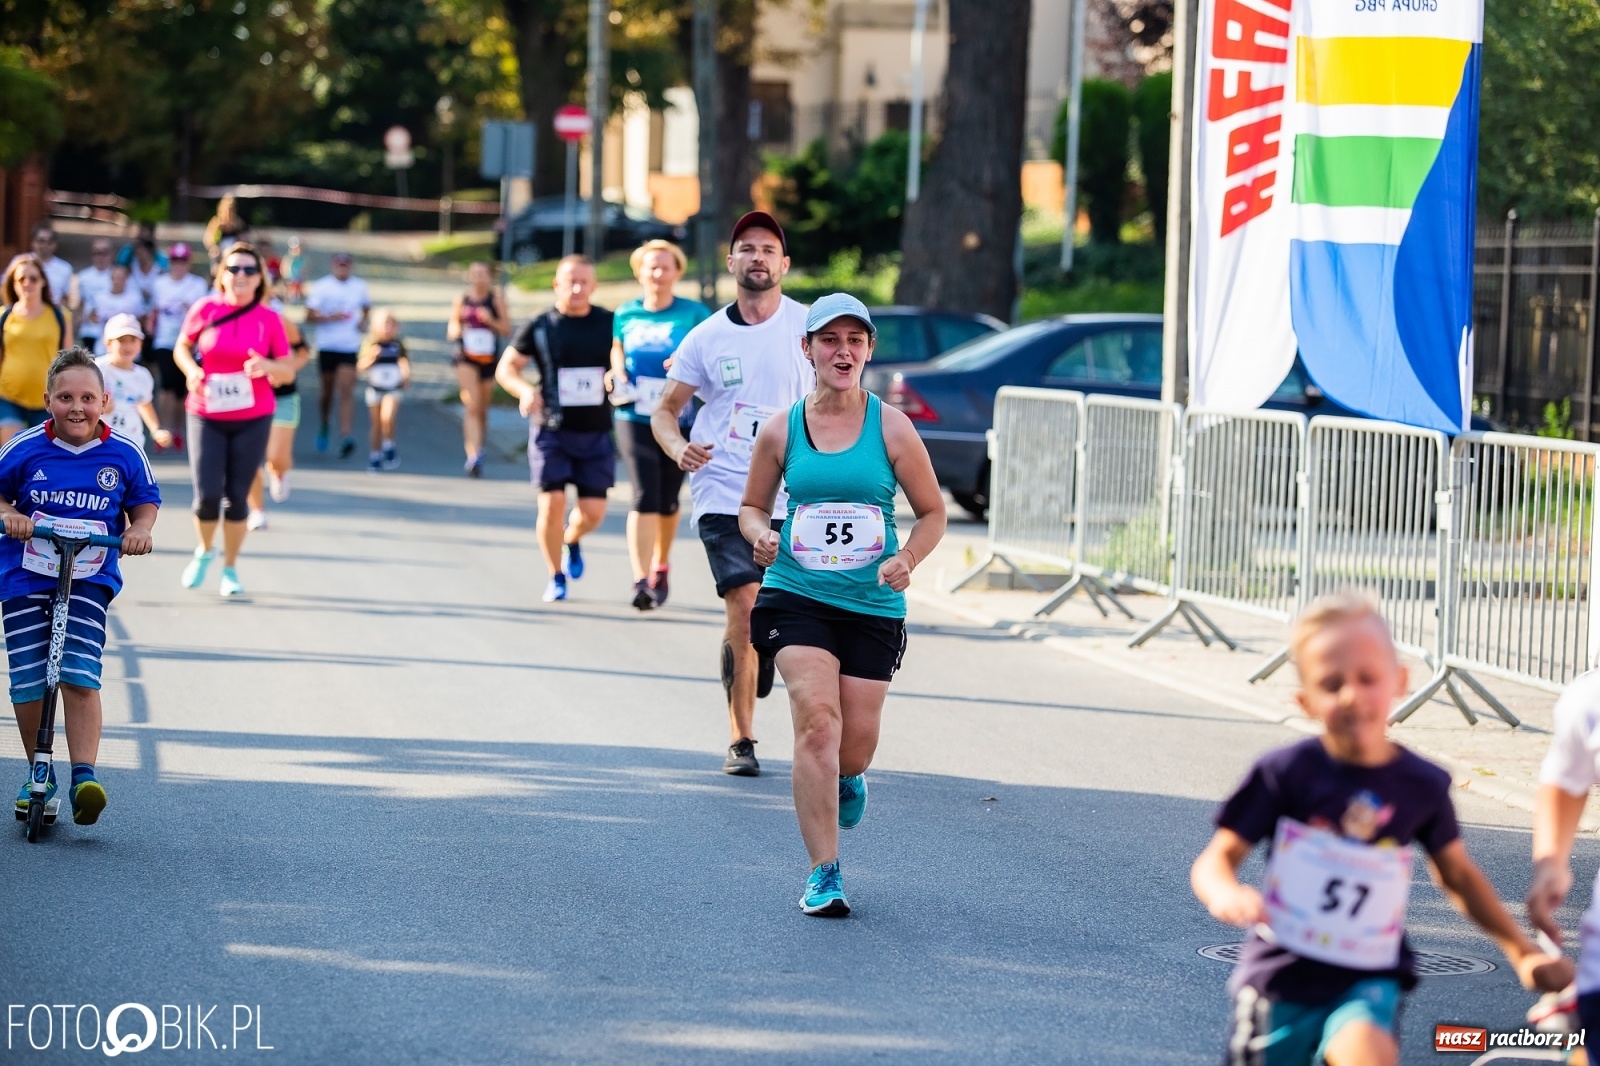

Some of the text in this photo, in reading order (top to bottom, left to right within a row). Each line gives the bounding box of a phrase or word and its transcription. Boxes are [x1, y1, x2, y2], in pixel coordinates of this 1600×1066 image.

[1208, 0, 1291, 237] RAFA
[30, 489, 110, 511] SAMSUNG
[825, 522, 854, 545] 55
[1319, 877, 1371, 919] 57
